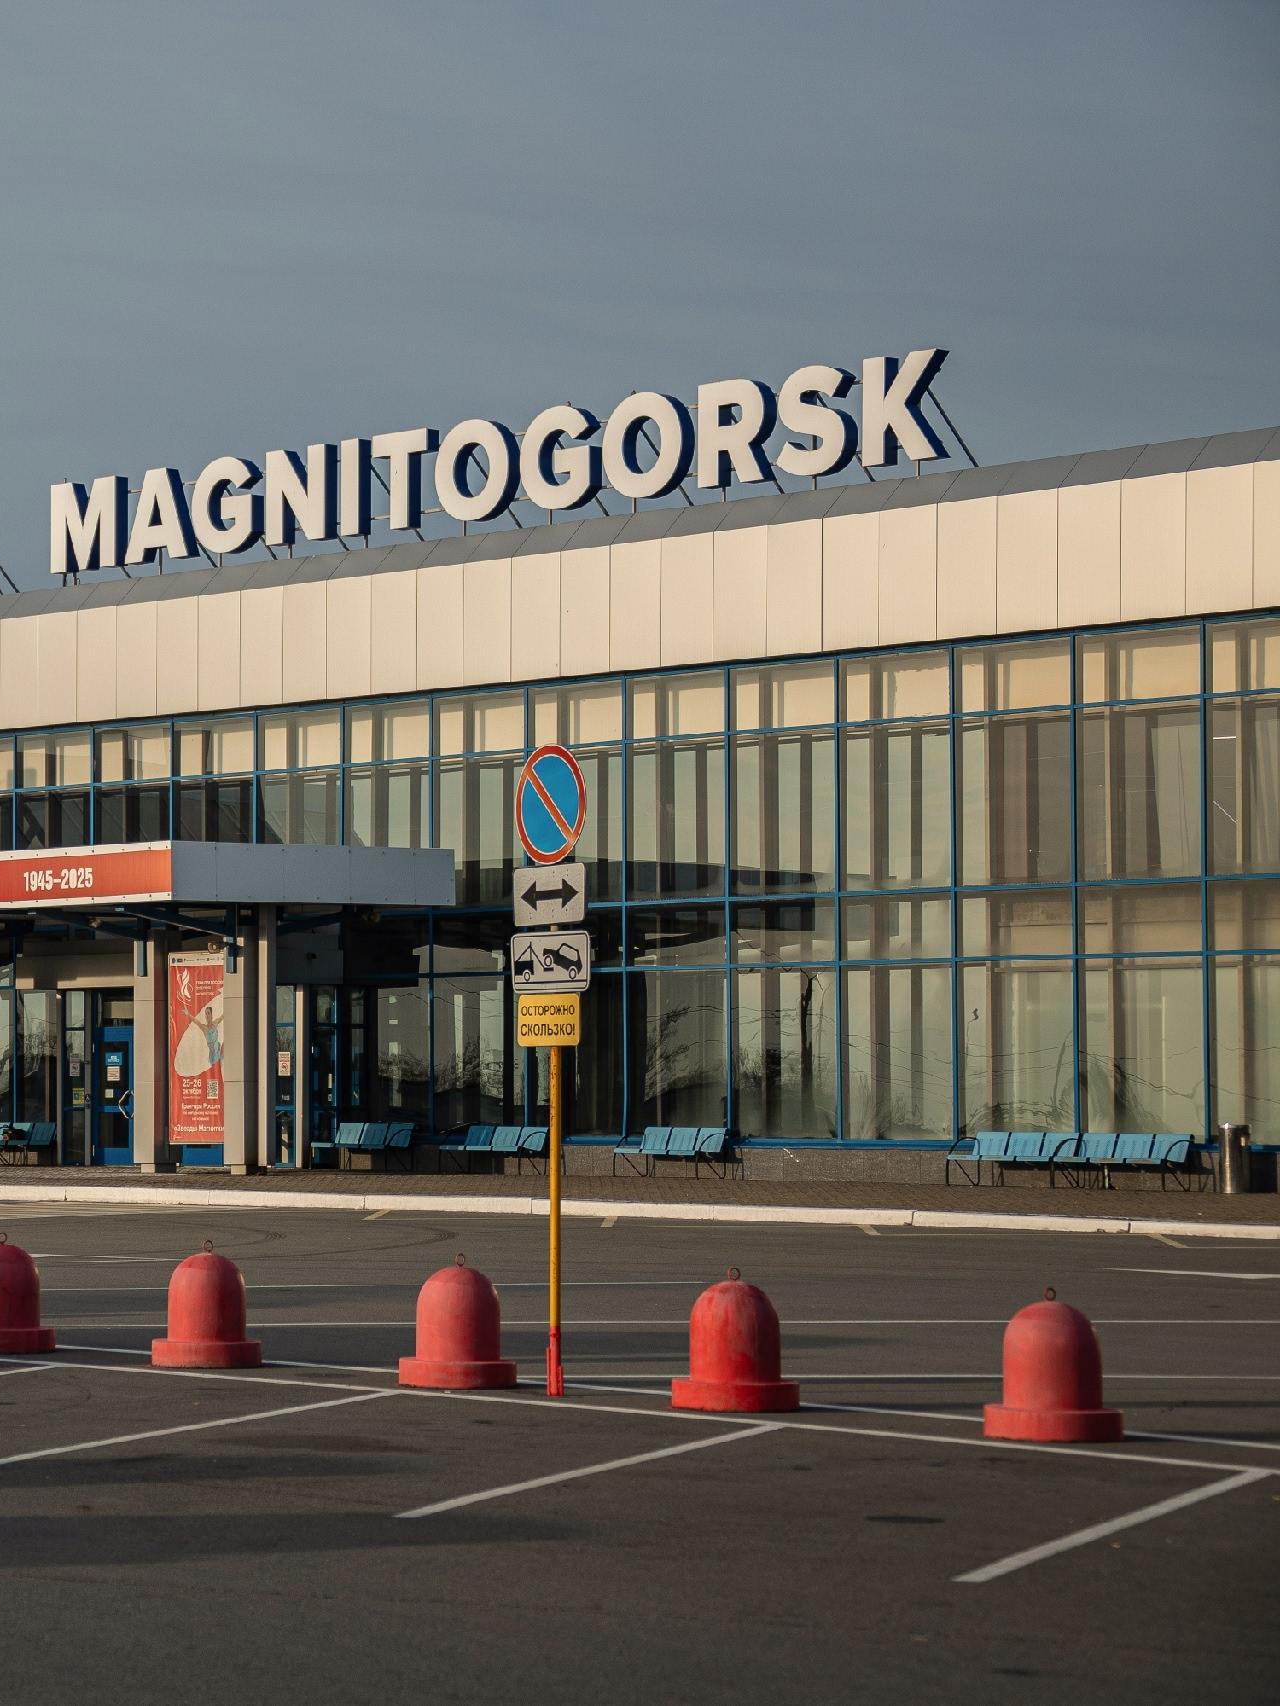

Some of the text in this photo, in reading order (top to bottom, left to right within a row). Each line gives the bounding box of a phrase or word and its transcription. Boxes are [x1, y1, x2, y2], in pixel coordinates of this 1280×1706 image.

[50, 349, 950, 574] MAGNITOGORSK
[521, 1004, 575, 1016] ОСТОРОЖНО
[520, 1024, 575, 1036] СКОЛЬЗКО!
